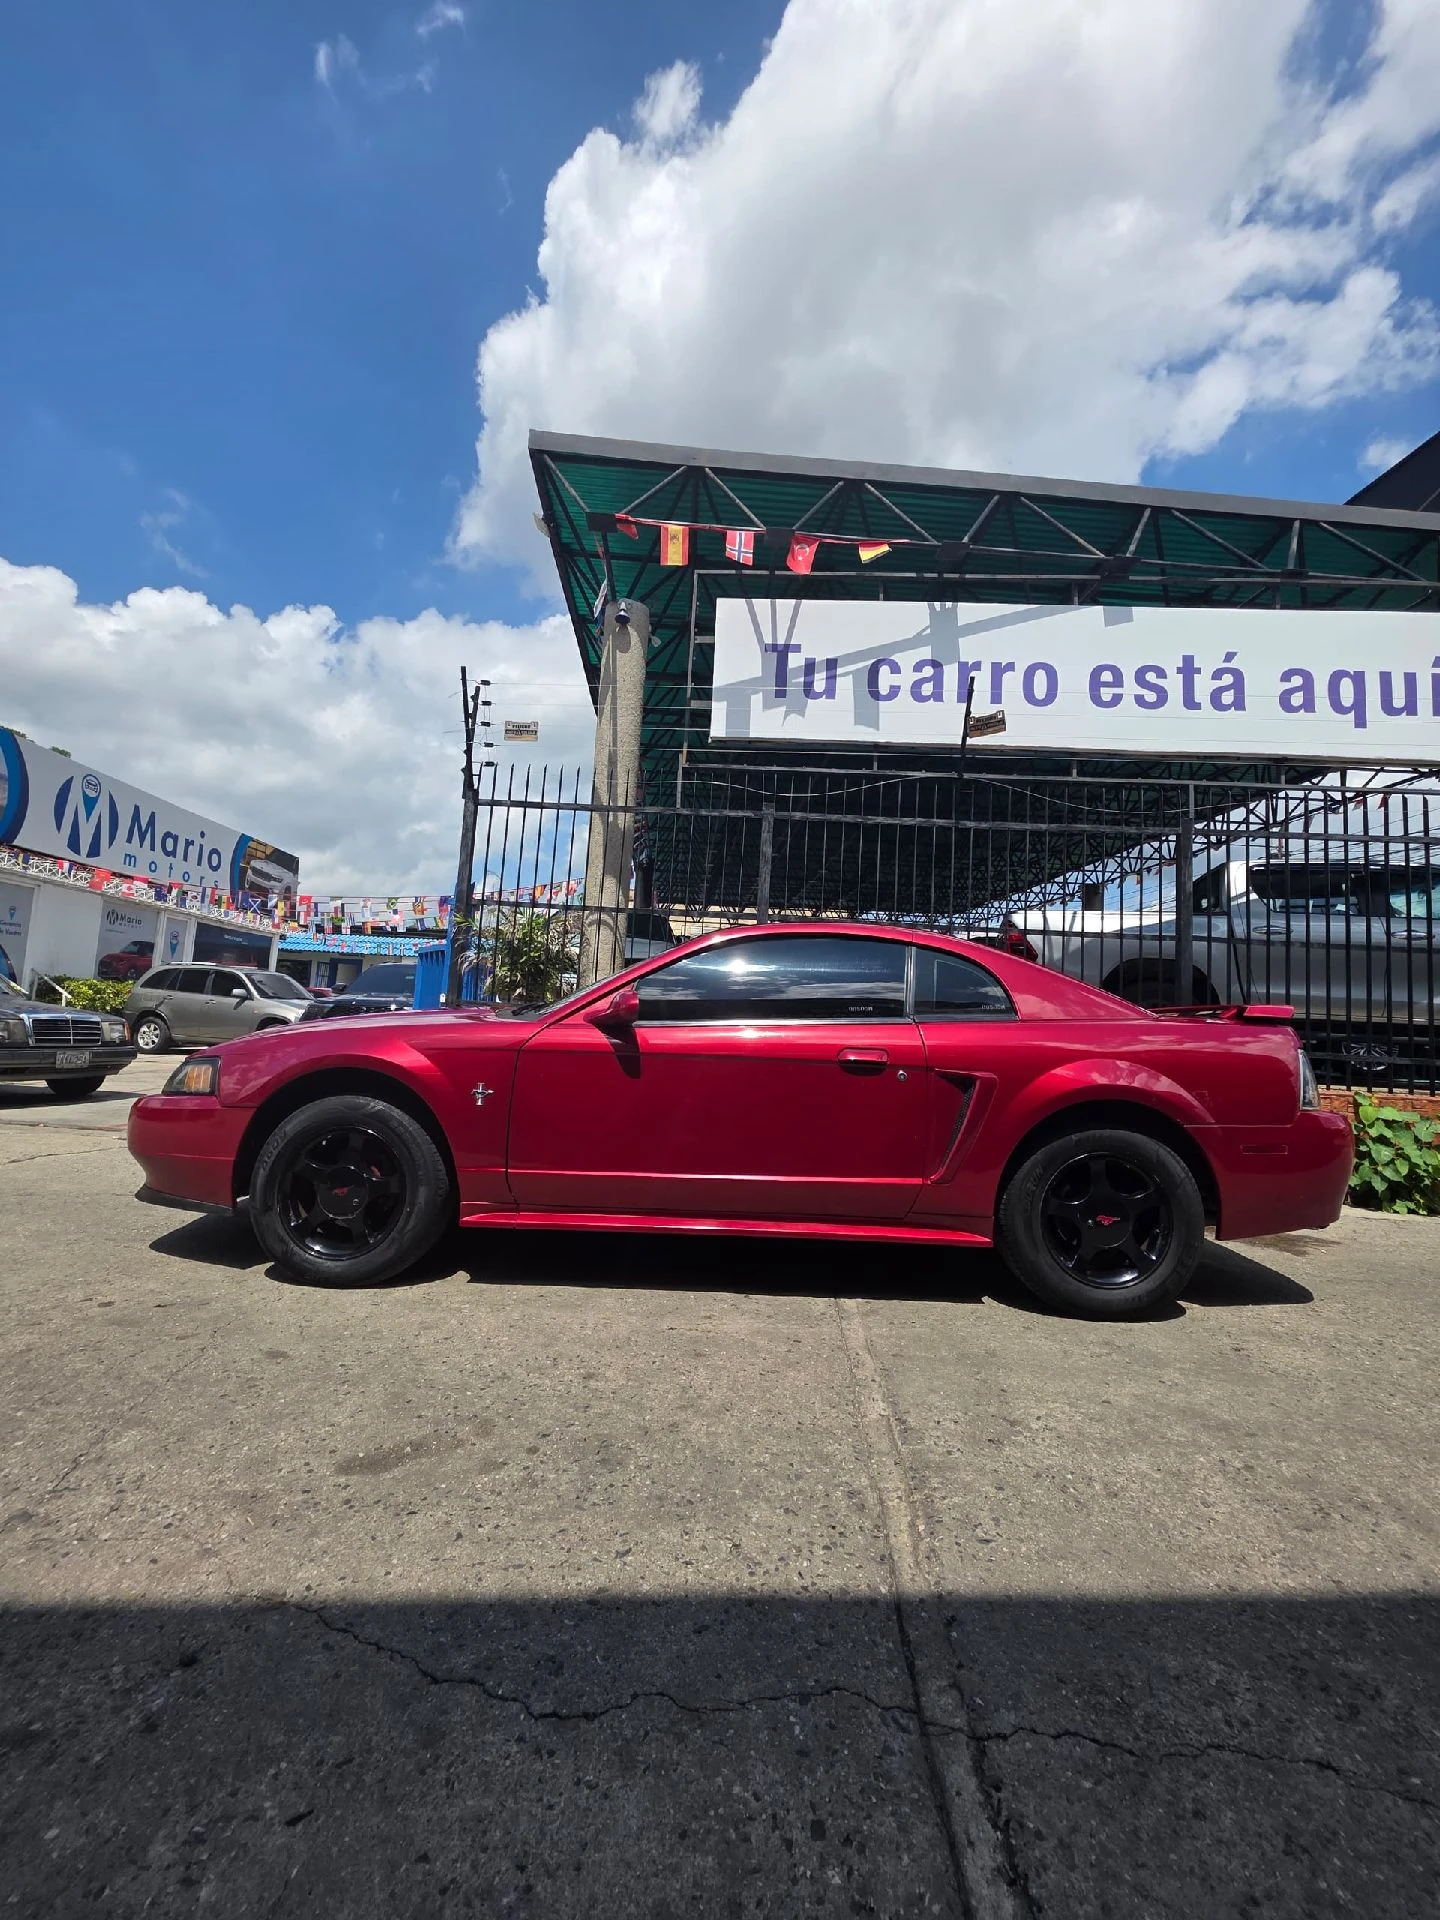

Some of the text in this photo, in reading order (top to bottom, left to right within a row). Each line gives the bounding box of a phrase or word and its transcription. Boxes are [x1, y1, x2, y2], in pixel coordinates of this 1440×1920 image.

[765, 644, 1440, 728] Tu carro está aquí
[125, 804, 222, 872] Mario
[123, 851, 220, 891] motors
[119, 912, 142, 926] Mario
